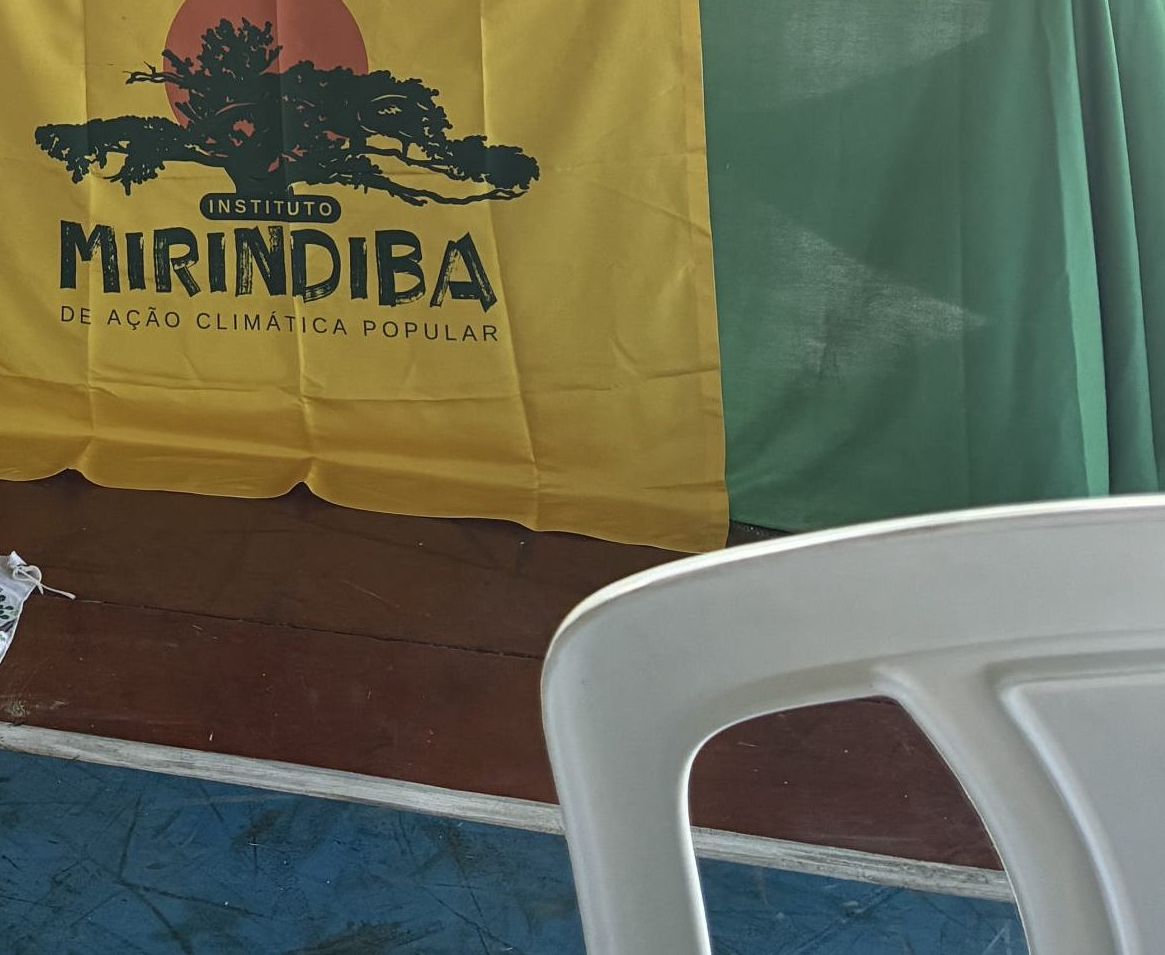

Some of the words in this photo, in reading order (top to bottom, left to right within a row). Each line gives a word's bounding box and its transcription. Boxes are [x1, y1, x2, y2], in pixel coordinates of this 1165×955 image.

[208, 199, 333, 217] INSTITUTO
[59, 220, 498, 313] MIRINDIBA
[60, 305, 92, 325] DE
[107, 307, 181, 330] AÇÃO
[197, 309, 348, 336] CLIMÁTICA
[363, 320, 499, 342] POPULAR
